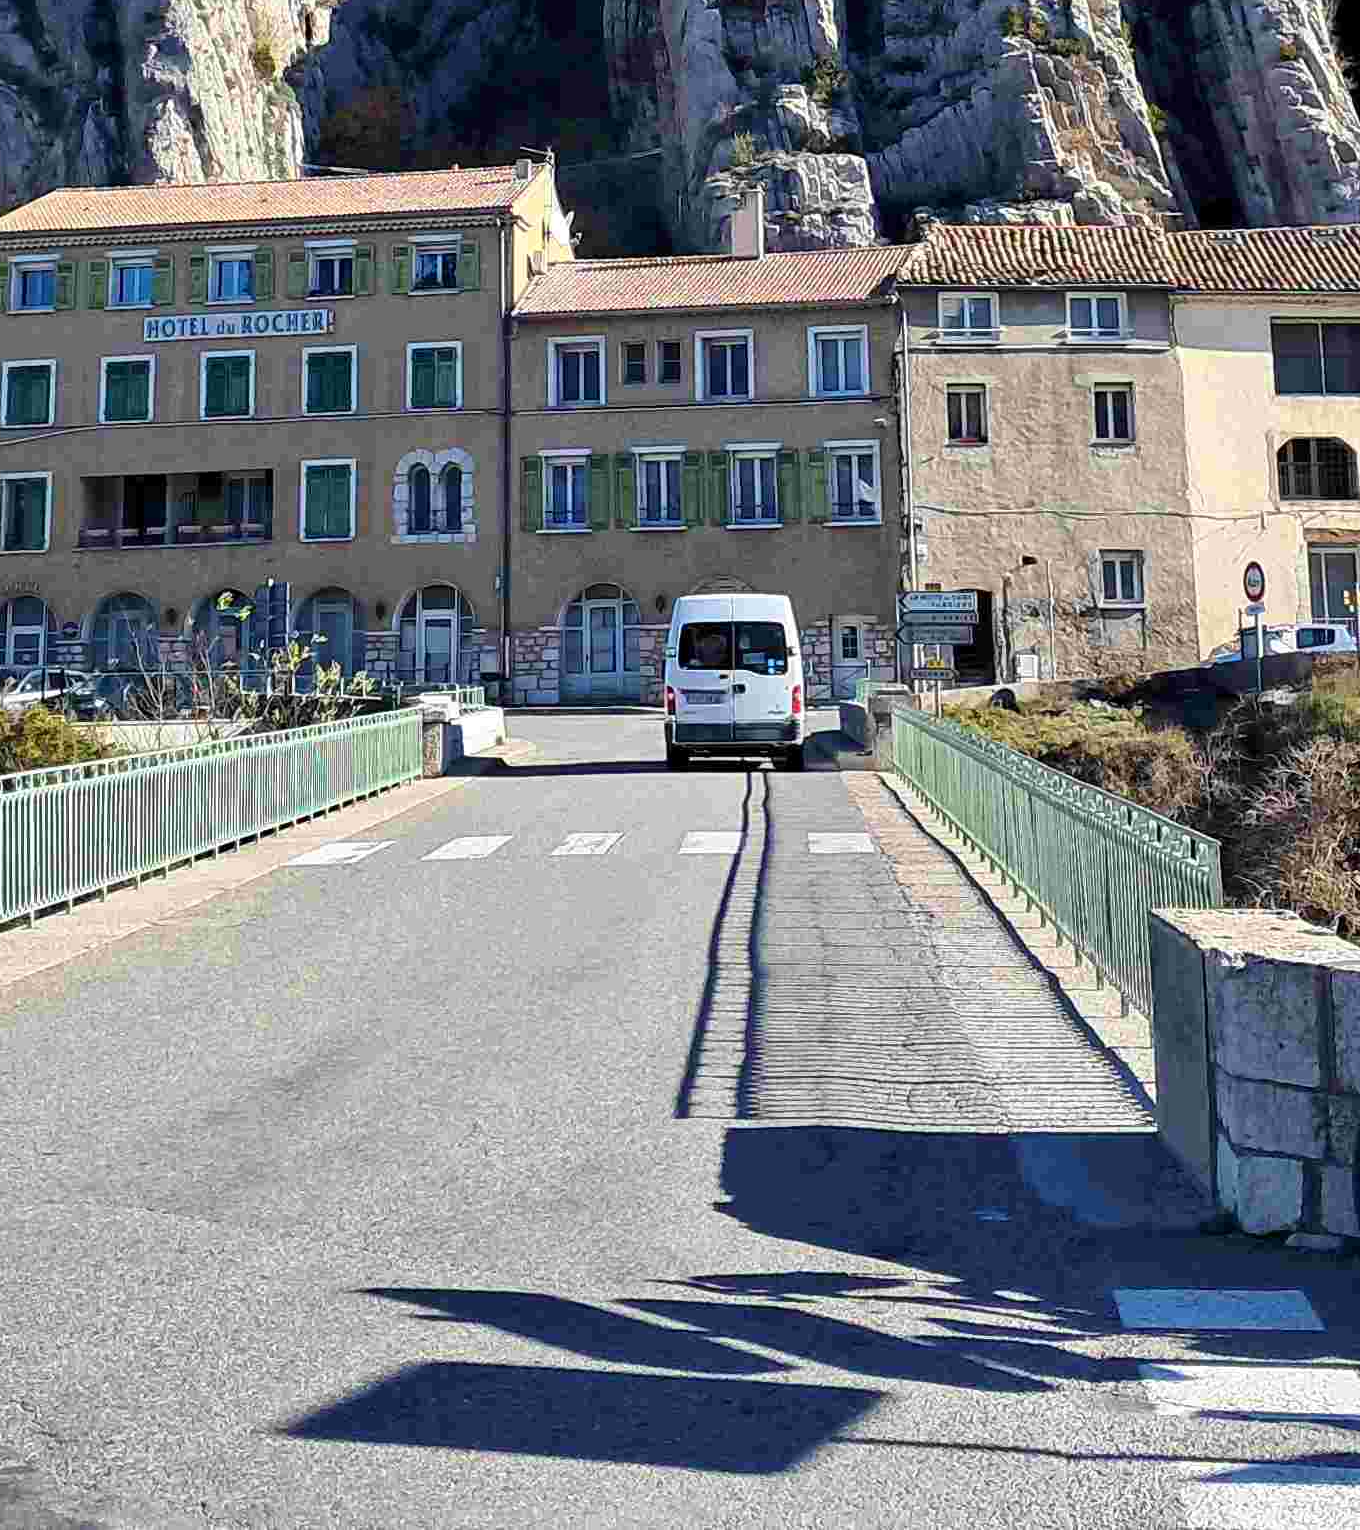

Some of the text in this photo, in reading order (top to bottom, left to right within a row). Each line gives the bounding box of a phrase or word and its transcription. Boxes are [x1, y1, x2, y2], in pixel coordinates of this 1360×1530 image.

[145, 312, 323, 338] HOTEL du ROCHER
